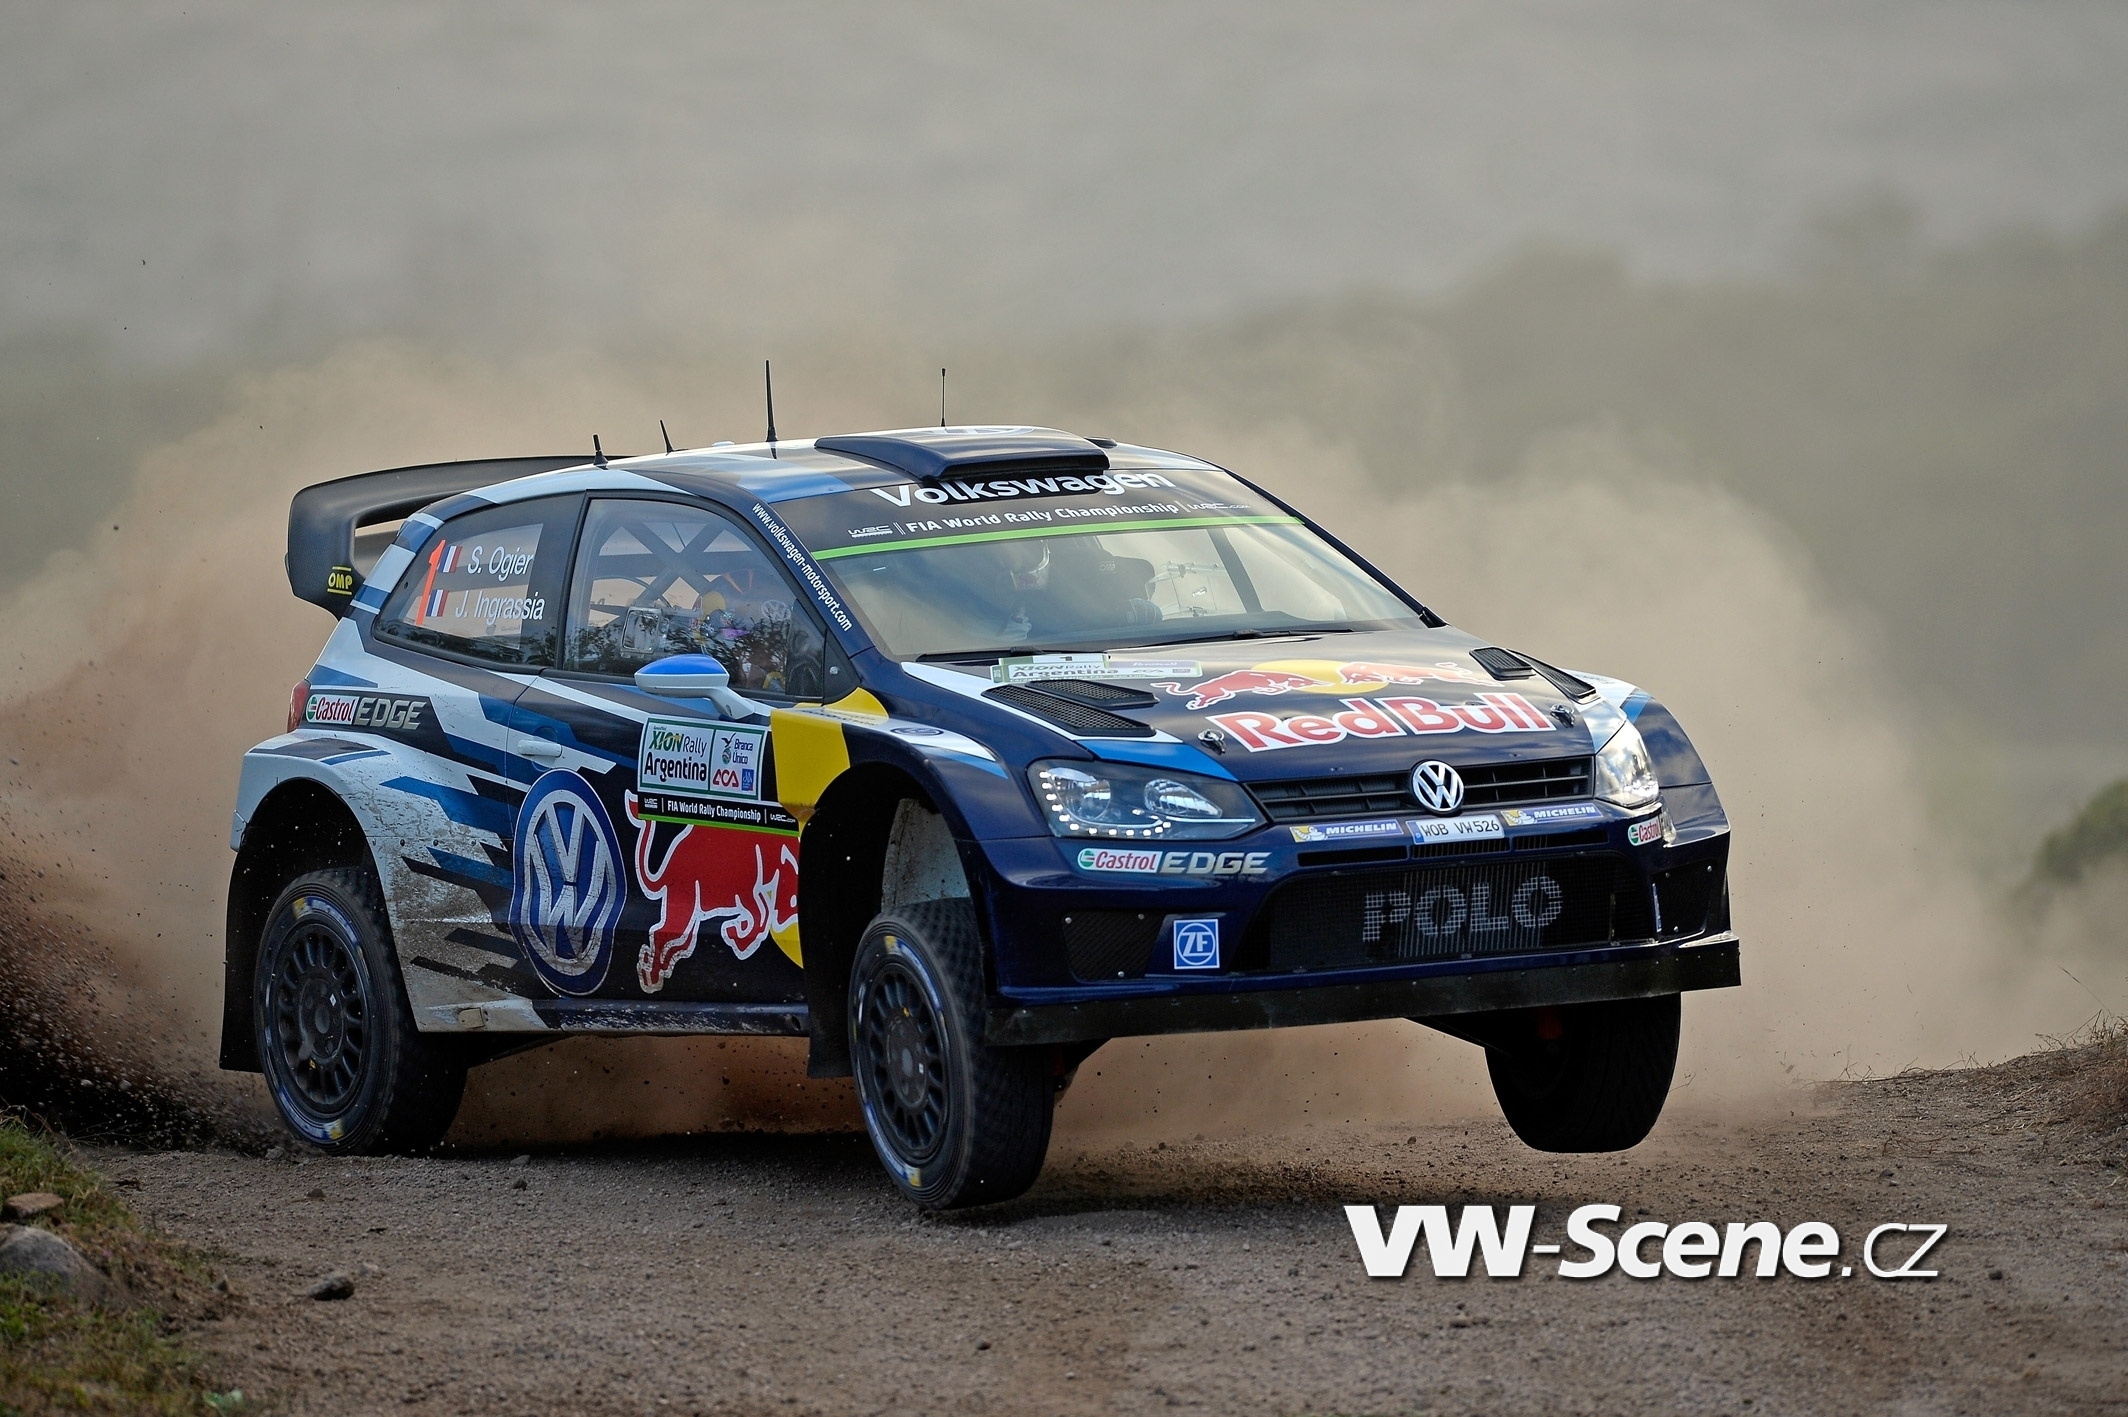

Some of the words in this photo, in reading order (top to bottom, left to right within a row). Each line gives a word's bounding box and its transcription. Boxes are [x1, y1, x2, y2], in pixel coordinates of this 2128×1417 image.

[869, 471, 1176, 508] Volkswagen
[905, 521, 943, 533] FIA
[942, 514, 1001, 529] World
[1004, 508, 1053, 523] Rally
[1055, 501, 1179, 519] Championship
[467, 546, 483, 574] S.
[489, 546, 534, 581] Ogier
[752, 503, 853, 632] www.volkswagen-motorsport.com
[328, 572, 353, 590] OMP
[455, 590, 469, 618] J.
[474, 590, 545, 626] Ingrassia
[315, 696, 355, 722] Castrol
[353, 697, 427, 730] EDGE
[734, 739, 754, 752] Branca
[644, 752, 707, 783] Argentina
[667, 800, 679, 812] FIA
[678, 801, 698, 815] World
[699, 803, 716, 818] Rally
[716, 805, 762, 823] Championship
[1534, 805, 1596, 820] MICHELIN
[1326, 821, 1397, 836] MICHELIN
[1420, 823, 1449, 838] WOB
[1095, 850, 1158, 871] Castrol
[1159, 851, 1272, 875] EDGE
[1362, 875, 1563, 943] POLO
[1182, 931, 1213, 957] ZF
